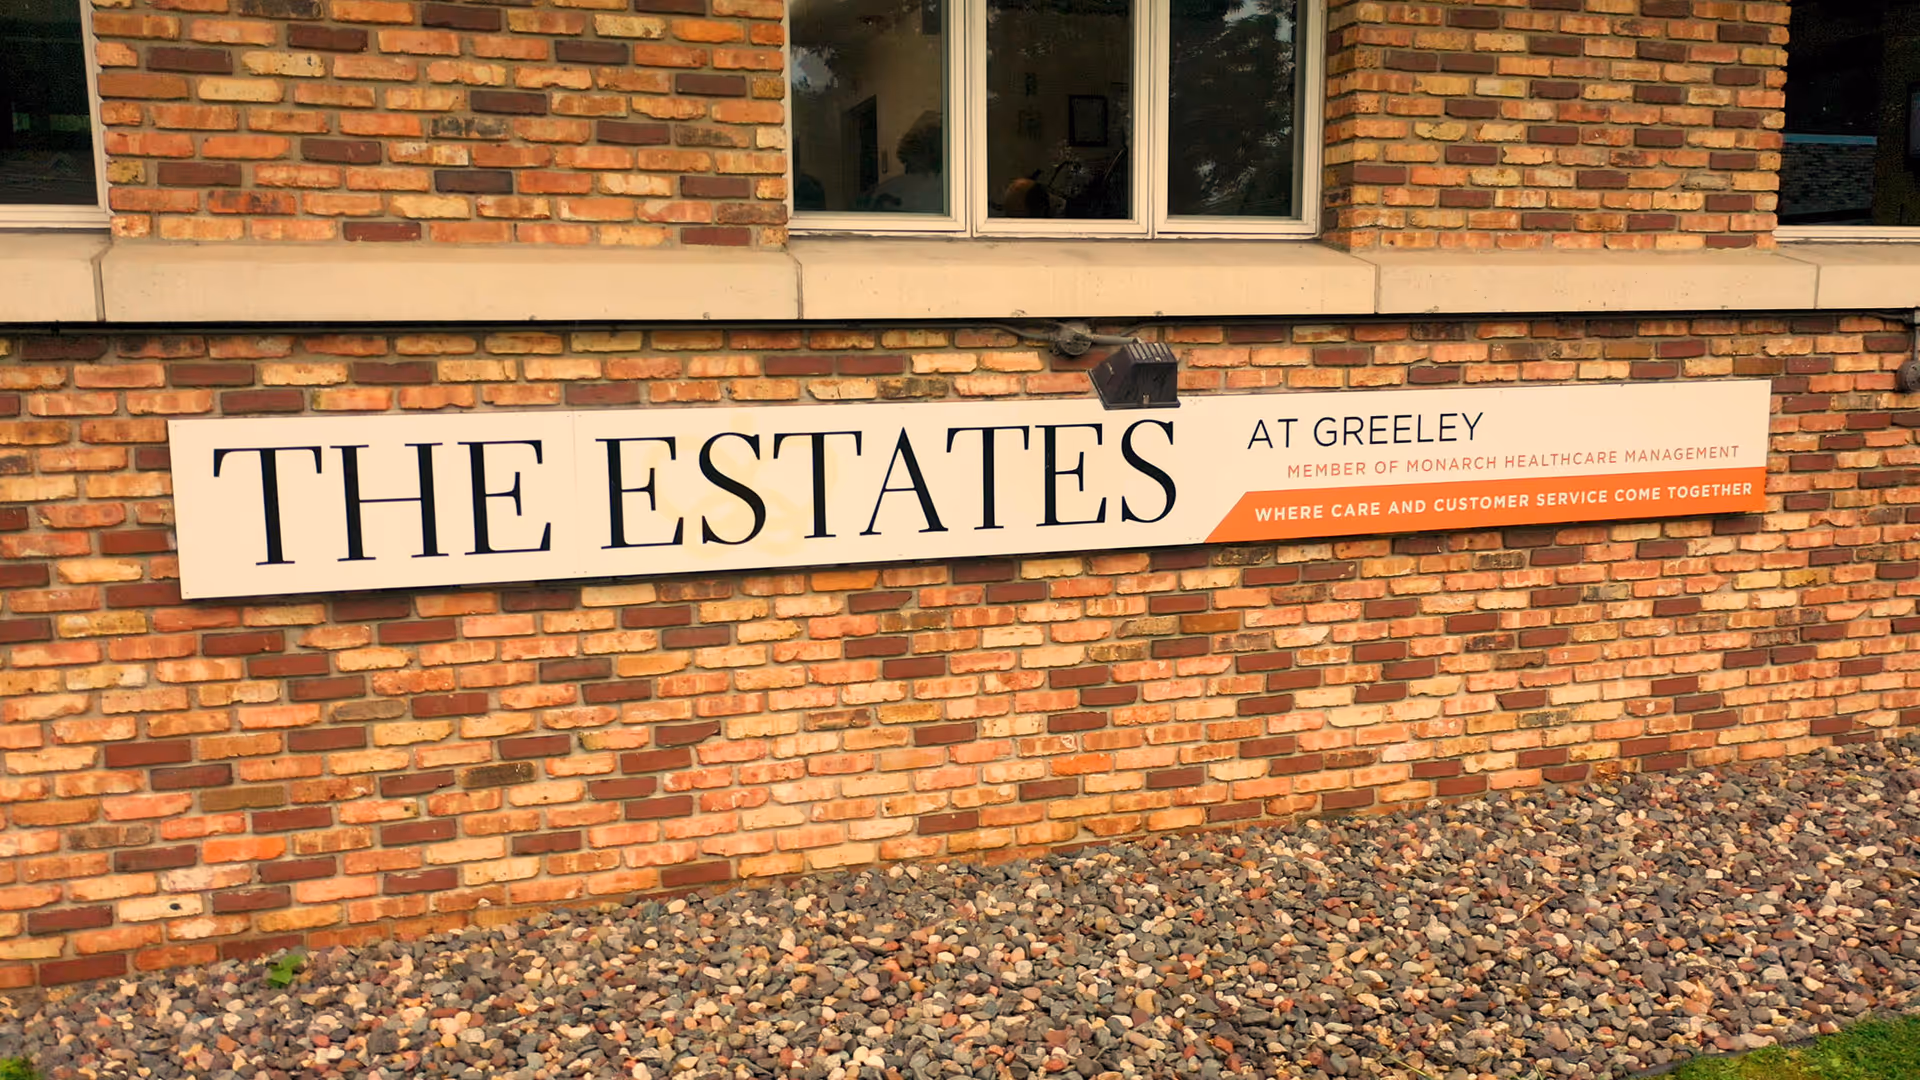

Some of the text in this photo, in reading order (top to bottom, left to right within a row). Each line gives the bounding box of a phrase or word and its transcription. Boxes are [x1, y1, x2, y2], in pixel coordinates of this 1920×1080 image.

[1247, 411, 1484, 449] AT GREELEY
[1287, 445, 1739, 479] MEMBER OF MONARCH HEALTHCARE MANAGEMENT
[213, 420, 1176, 566] THE ESTATES
[1255, 481, 1753, 522] WHERE CARE AND CUSTOMER SERVICE COME TOGETHER
